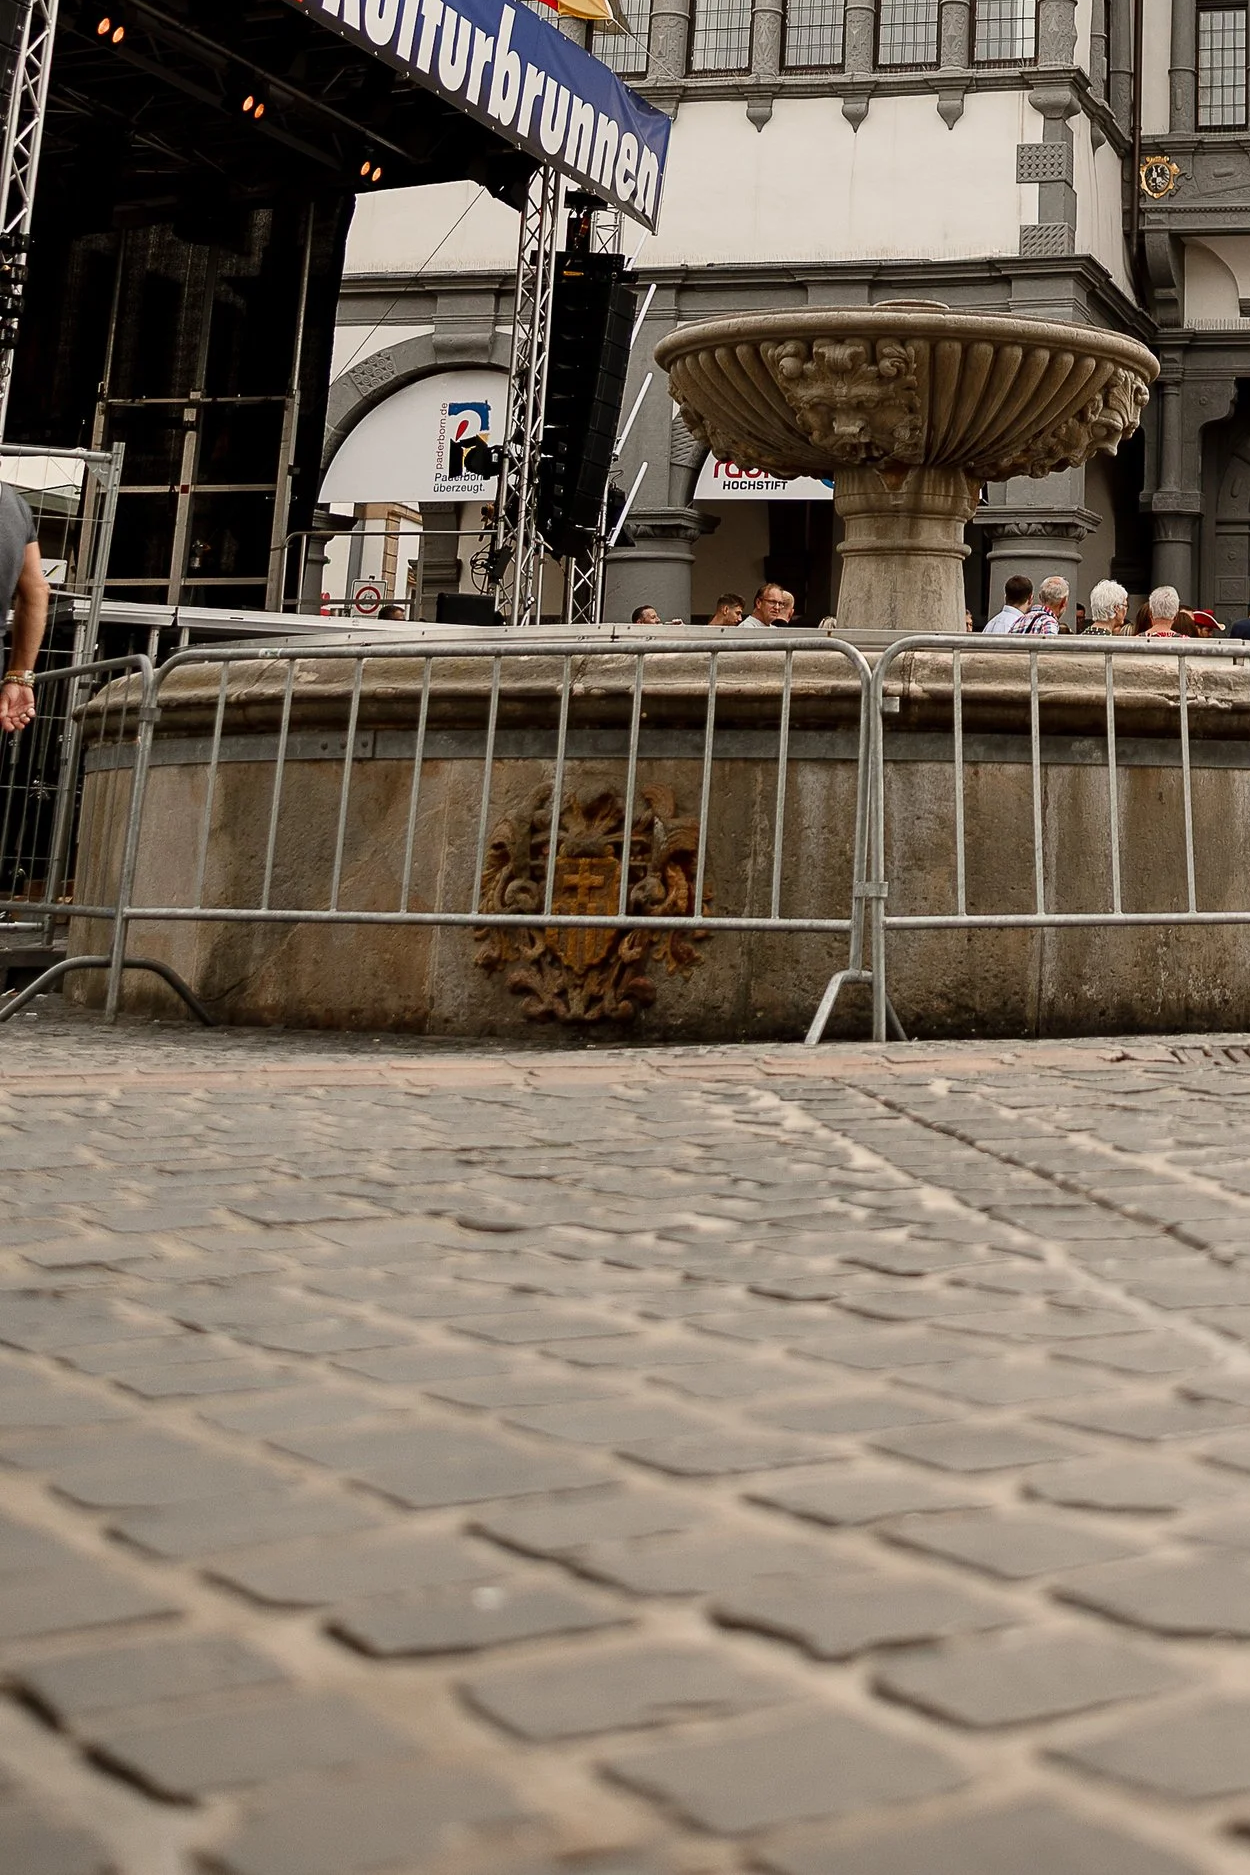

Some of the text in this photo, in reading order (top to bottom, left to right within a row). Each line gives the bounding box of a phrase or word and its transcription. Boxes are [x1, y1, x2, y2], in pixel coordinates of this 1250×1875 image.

[436, 403, 448, 470] paderborn.de
[433, 483, 485, 493] überzeugt.
[722, 480, 788, 490] HOCHSTIFT
